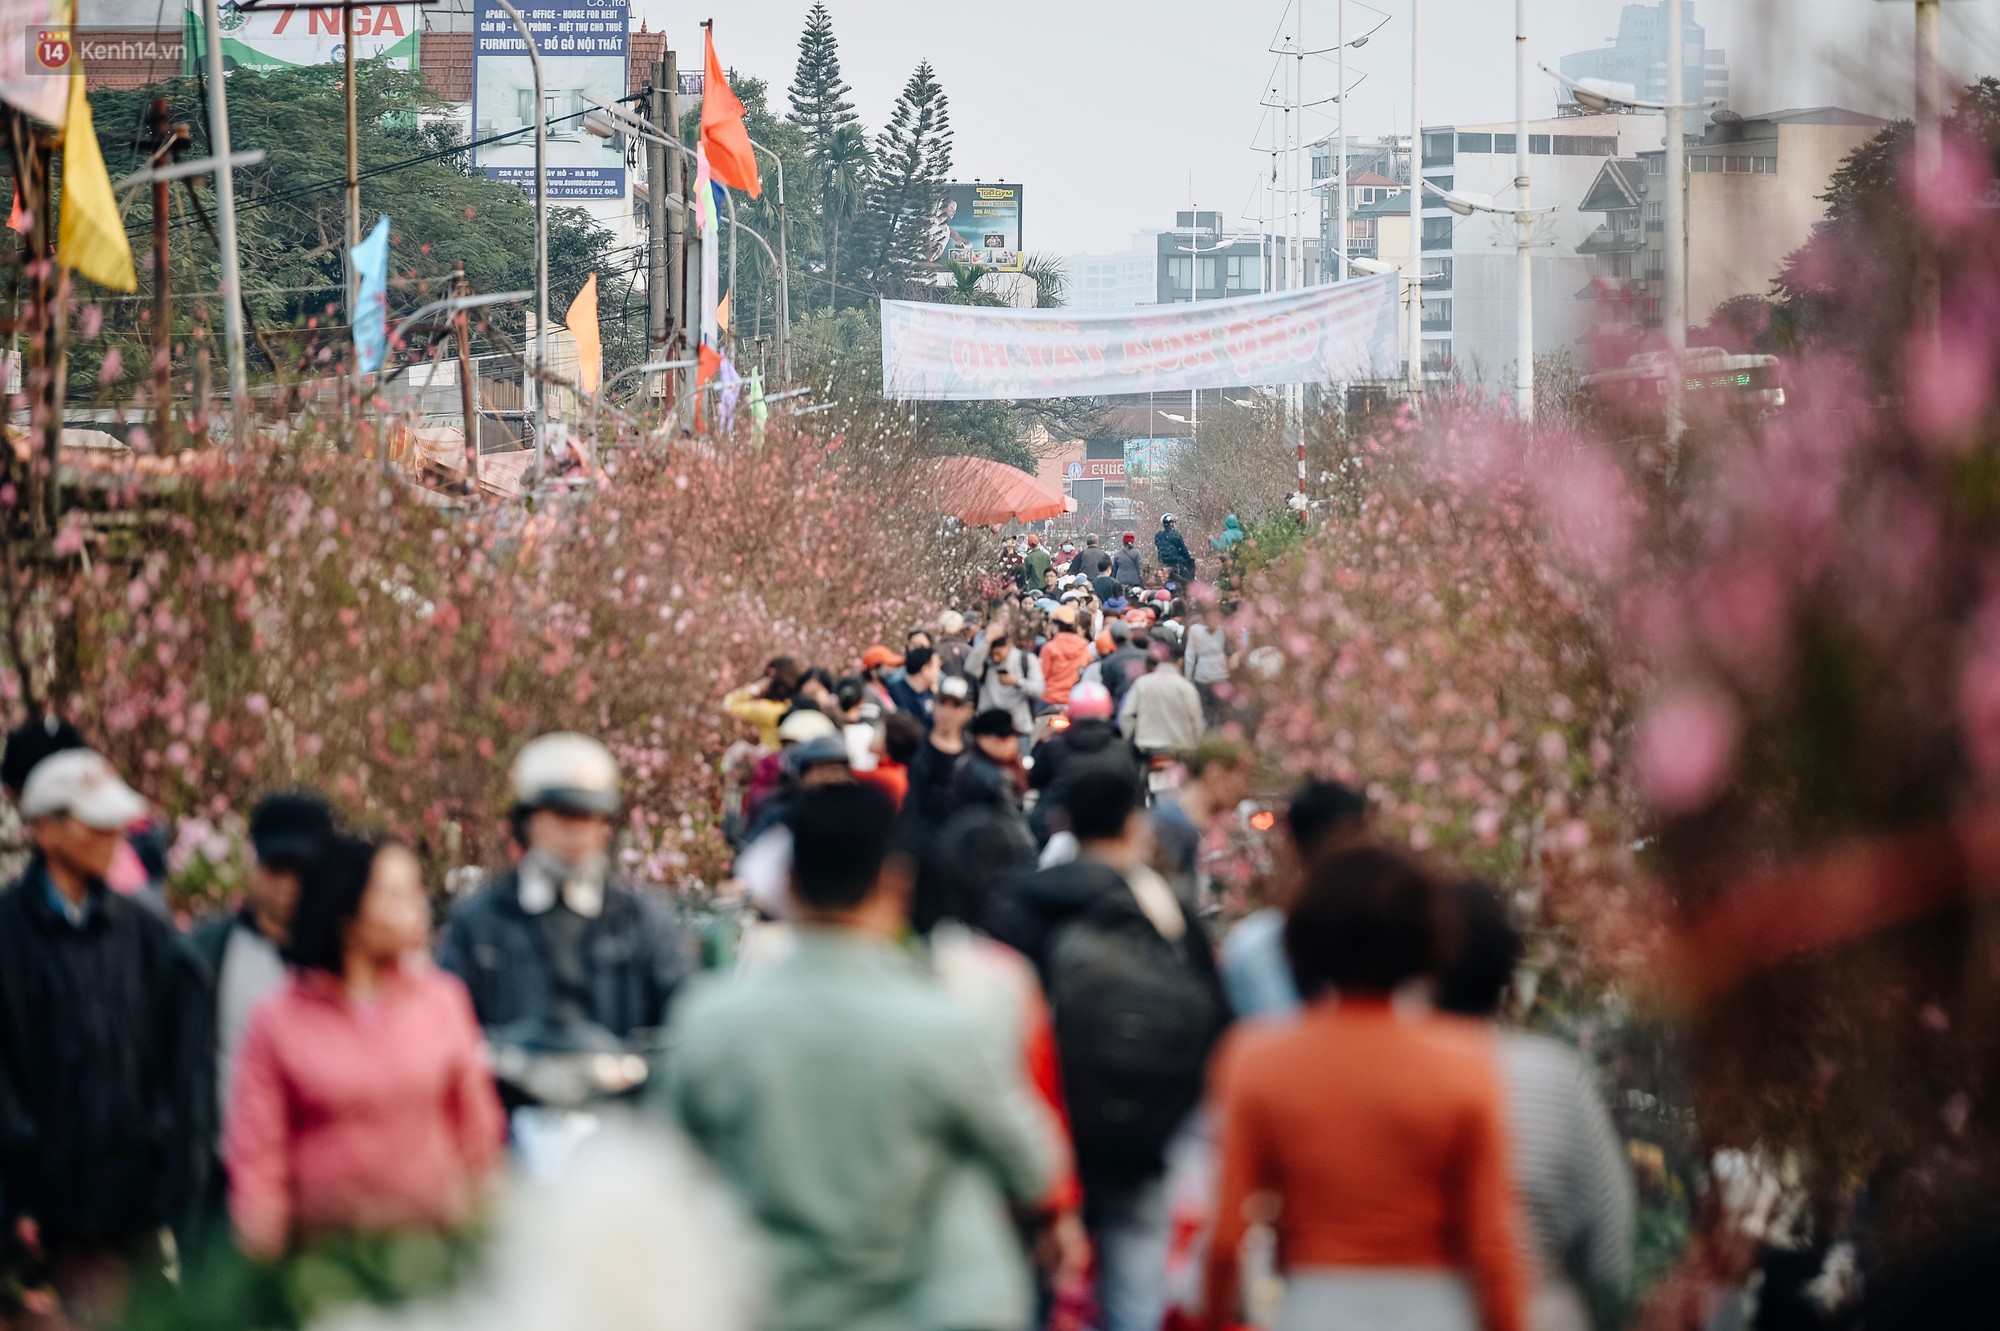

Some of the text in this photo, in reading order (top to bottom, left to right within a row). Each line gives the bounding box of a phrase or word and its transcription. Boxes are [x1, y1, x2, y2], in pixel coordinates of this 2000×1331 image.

[267, 4, 296, 35] 7
[485, 9, 618, 19] APARTENT OFFICE HOUSE FOR RENT
[480, 21, 495, 32] CĂN
[496, 21, 506, 34] HỘ
[529, 21, 552, 32] PHÒNG
[559, 22, 575, 33] BIỆT
[575, 22, 589, 33] THỰ
[590, 22, 604, 32] CHO
[605, 21, 623, 32] THUÊ
[561, 35, 575, 50] GỖ
[577, 36, 595, 53] NỘI
[598, 35, 623, 50] THẤT
[545, 169, 556, 177] ÂY
